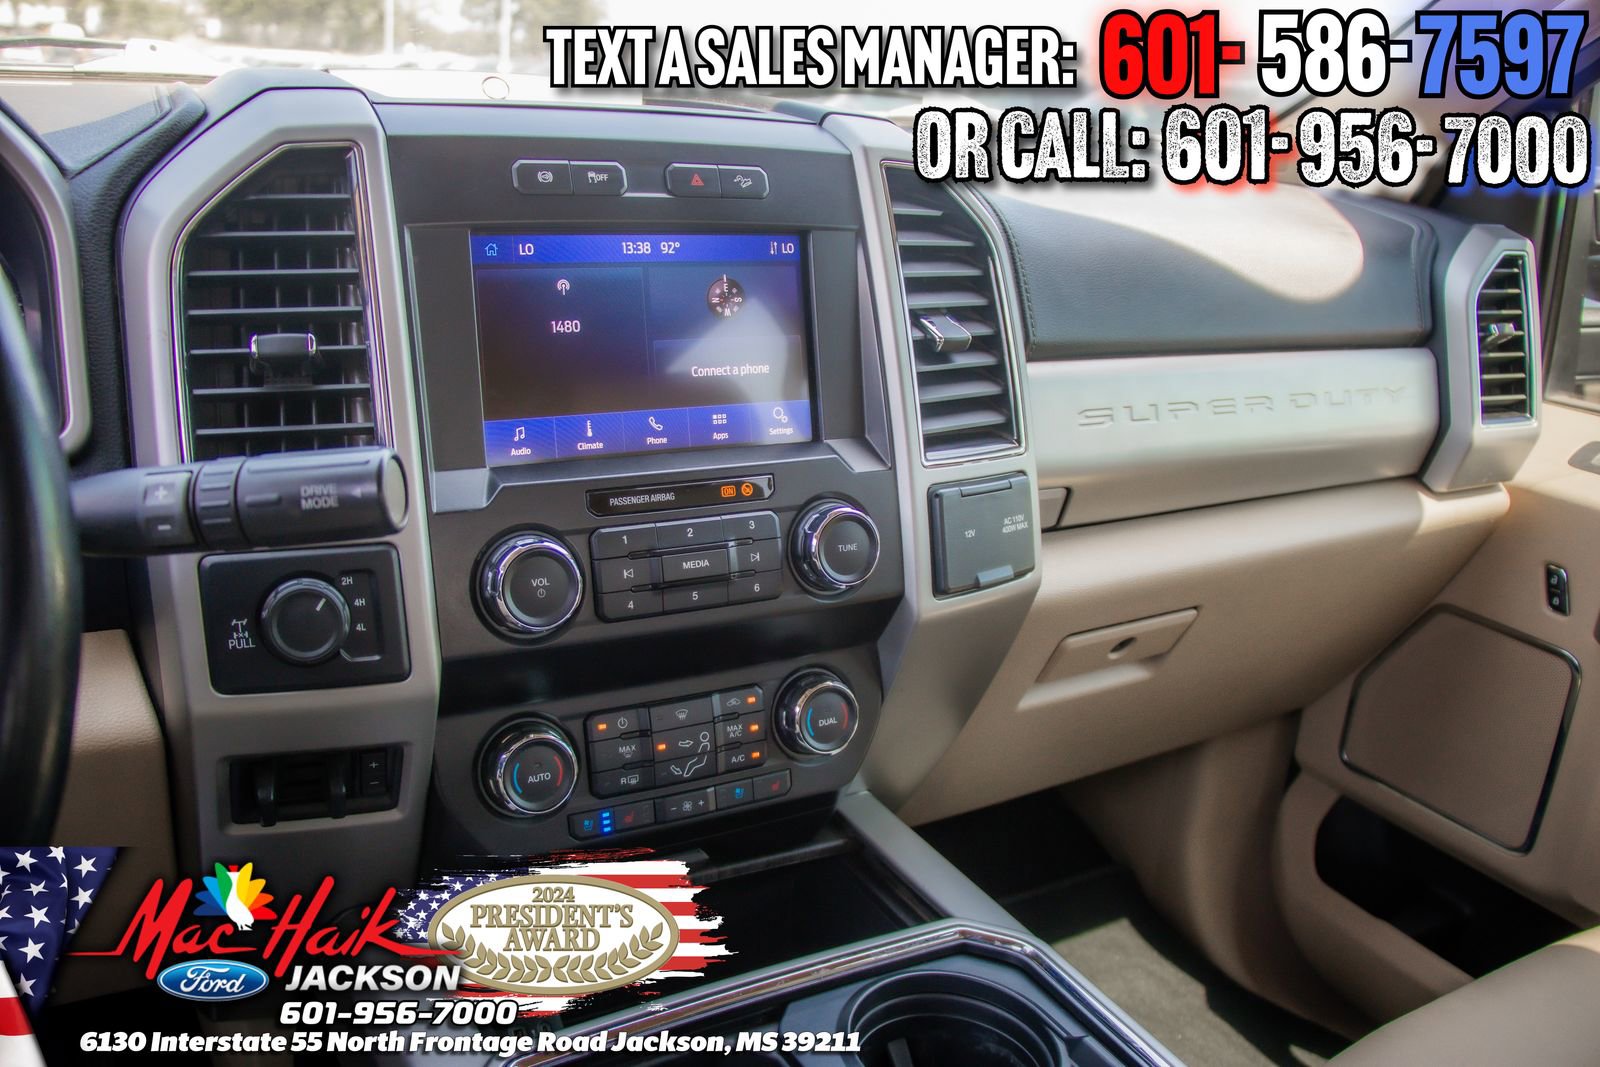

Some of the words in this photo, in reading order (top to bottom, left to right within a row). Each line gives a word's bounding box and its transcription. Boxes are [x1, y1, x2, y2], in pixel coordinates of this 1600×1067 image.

[595, 173, 608, 182] OFF
[519, 244, 534, 256] LO
[622, 242, 651, 255] 13:38
[660, 241, 680, 254] 92°
[781, 243, 795, 254] LO
[551, 320, 580, 334] 1480
[691, 364, 731, 378] Connect
[733, 367, 739, 375] a
[741, 363, 770, 378] phone
[1078, 395, 1274, 427] SUPER
[1289, 386, 1406, 409] DUTY
[769, 425, 794, 436] Settings
[647, 436, 668, 445] Phone
[713, 432, 729, 442] Apps
[577, 441, 604, 450] Climate
[511, 447, 531, 456] Audio
[301, 483, 338, 496] DRIVE
[301, 496, 339, 509] MODE
[609, 494, 650, 506] PASSENGER
[650, 492, 676, 503] AIRBAG
[748, 521, 756, 531] 3
[687, 528, 694, 538] 2
[965, 529, 976, 538] 12V
[622, 536, 628, 545] 1
[838, 542, 858, 553] TUNE
[682, 559, 710, 570] MEDIA
[341, 576, 354, 586] 2H
[531, 577, 550, 588] VOL
[753, 583, 761, 594] 6
[692, 591, 699, 601] 5
[354, 598, 366, 607] 4H
[627, 600, 634, 610] 4
[356, 623, 367, 632] 4L
[228, 638, 256, 650] PULL
[818, 716, 838, 727] DUAL
[727, 723, 743, 732] MAX
[618, 744, 637, 754] MAX
[731, 754, 746, 763] A/C
[527, 773, 551, 783] AUTO
